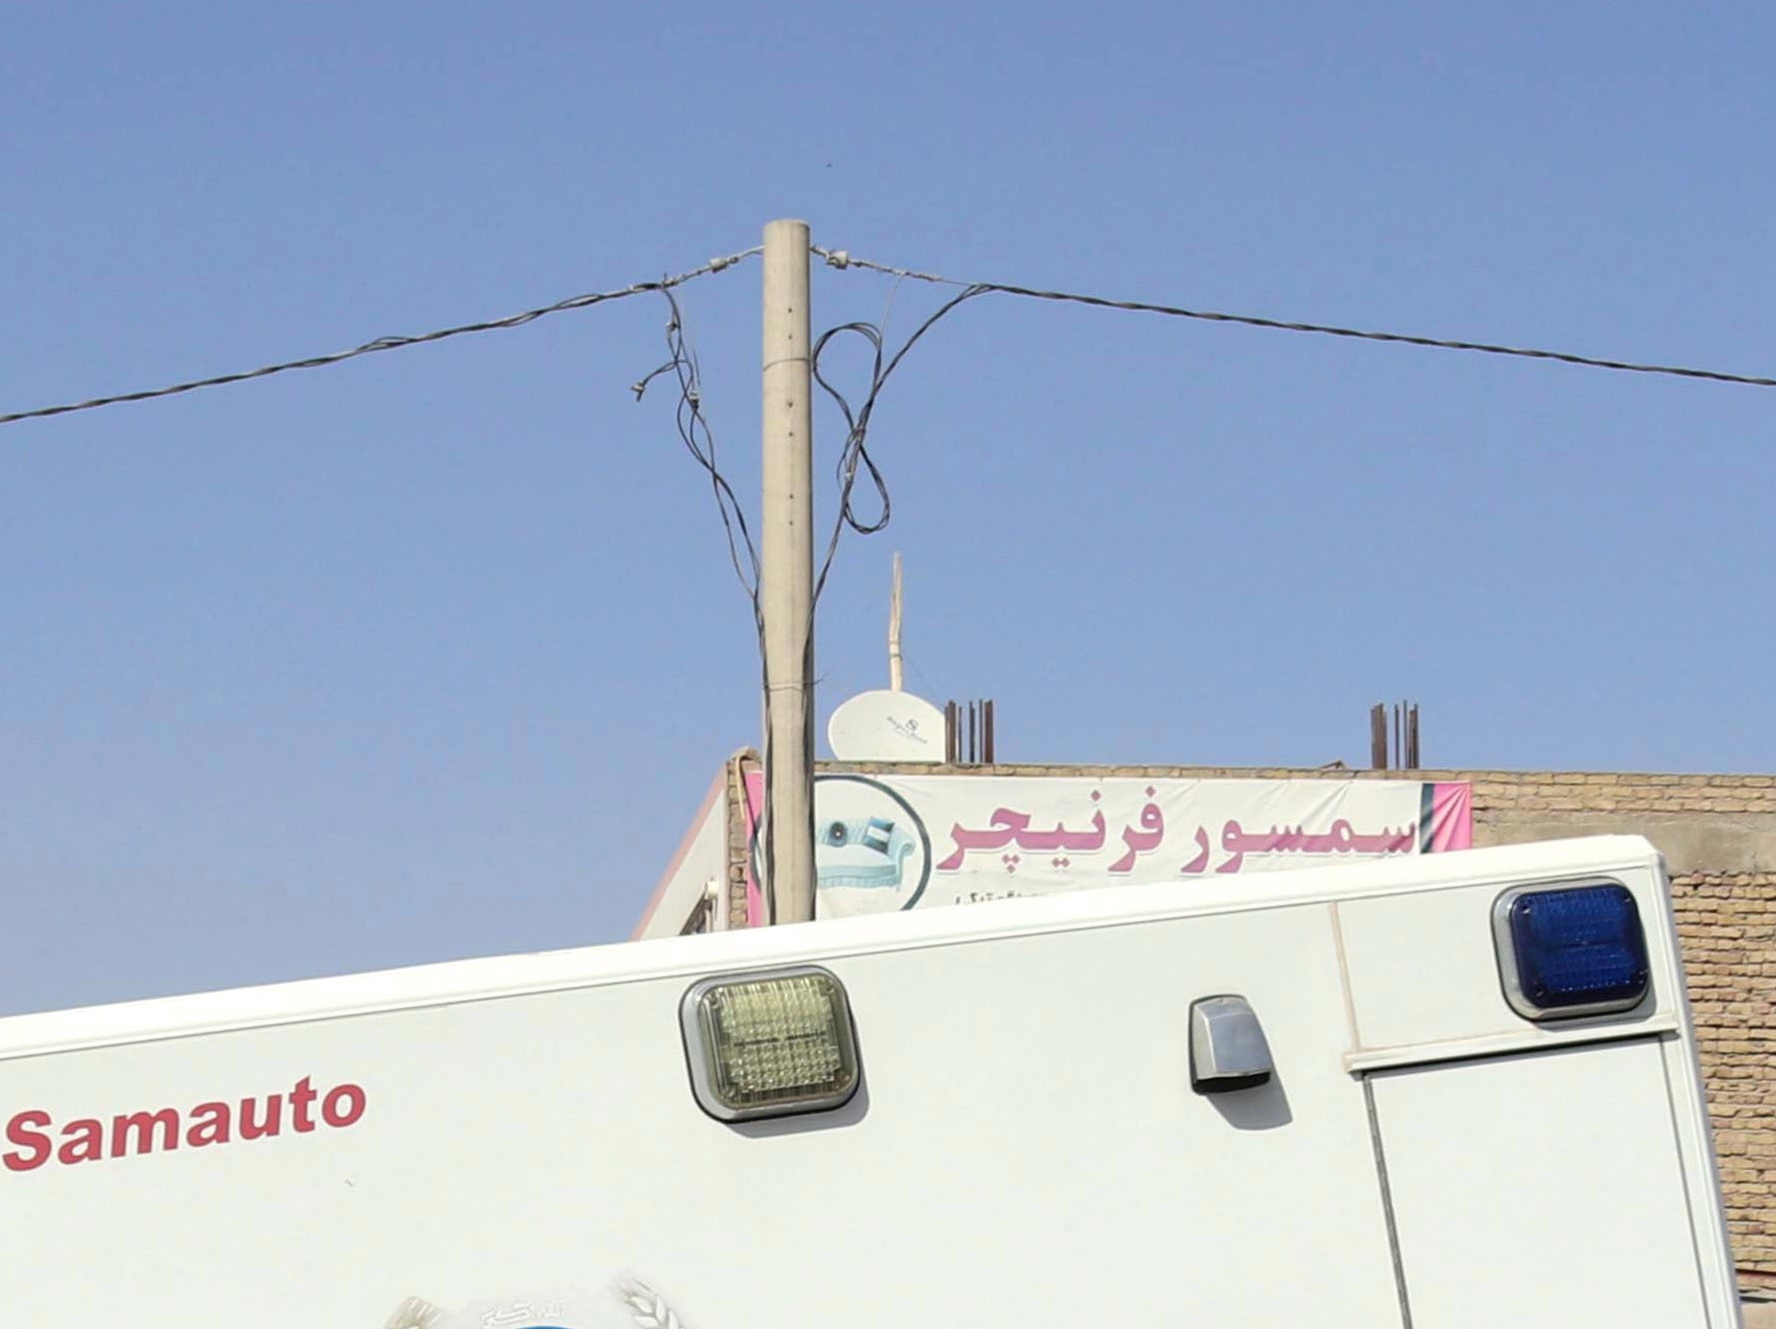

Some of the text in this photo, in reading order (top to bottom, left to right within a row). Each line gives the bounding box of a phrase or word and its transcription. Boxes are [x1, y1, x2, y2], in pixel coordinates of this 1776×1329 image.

[936, 786, 1416, 875] سمسور فرنیچر
[2, 1075, 367, 1172] Samauto
